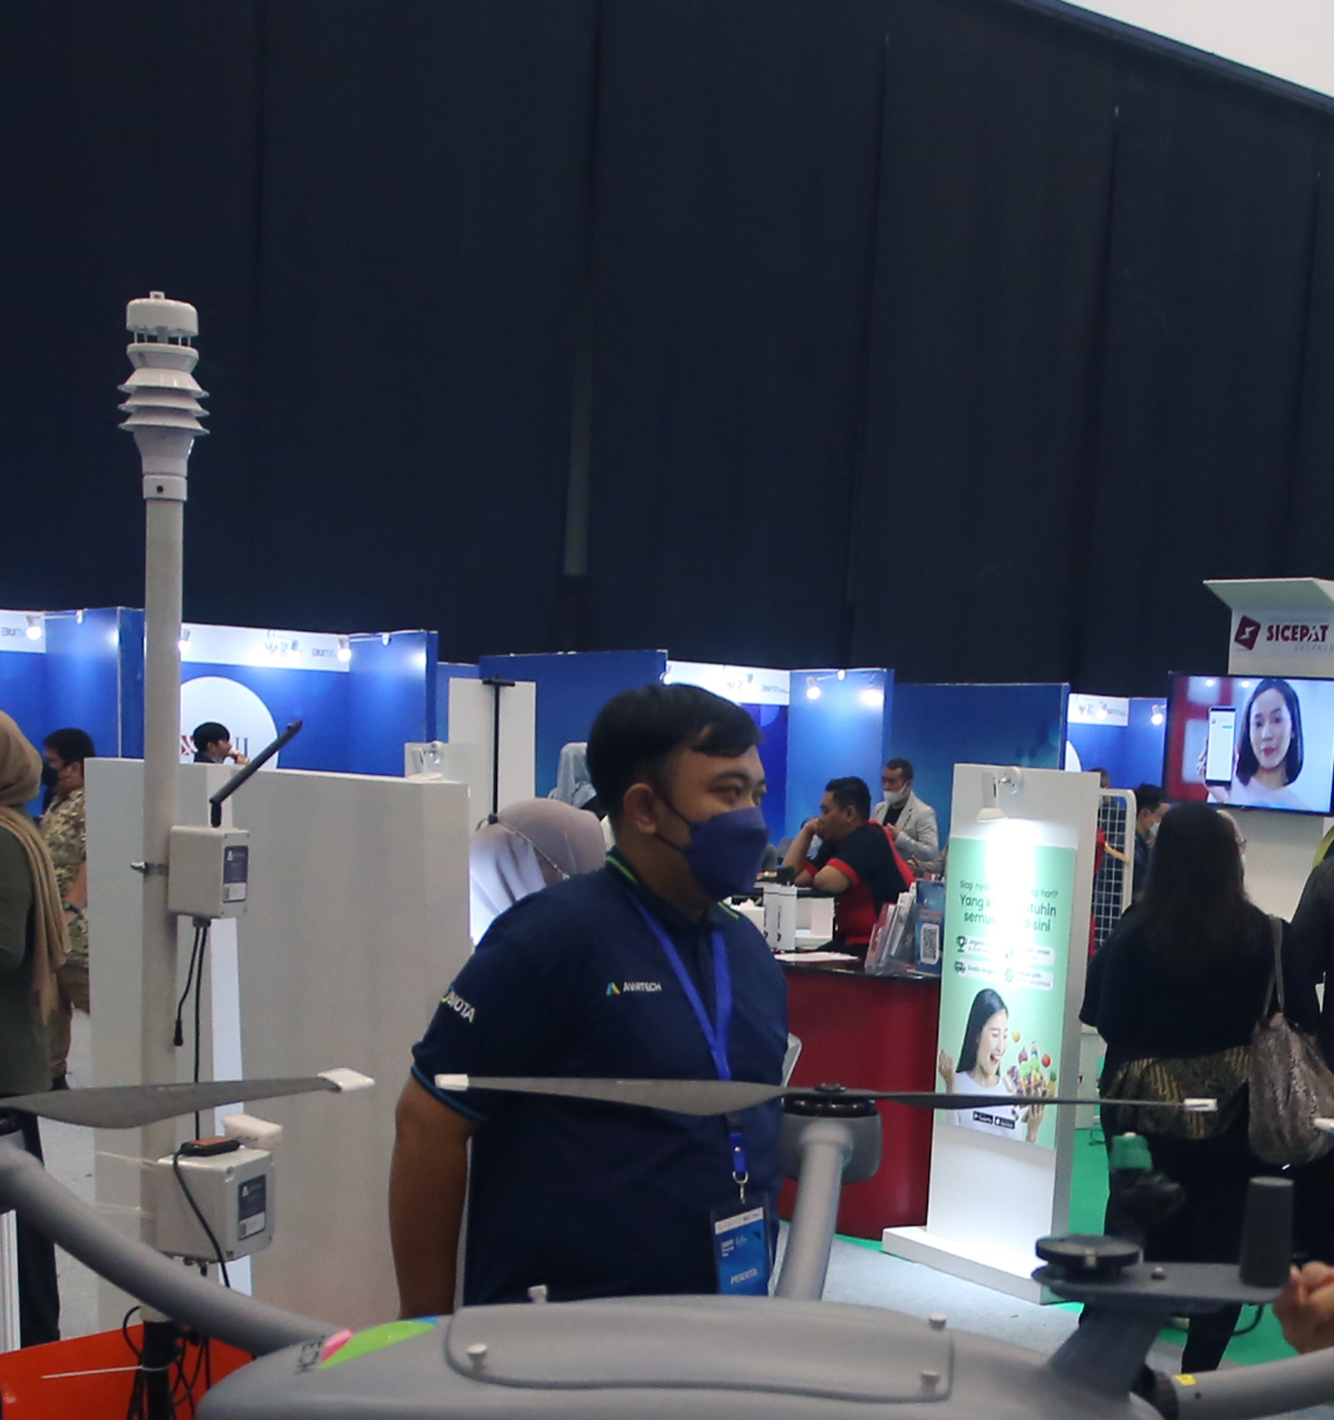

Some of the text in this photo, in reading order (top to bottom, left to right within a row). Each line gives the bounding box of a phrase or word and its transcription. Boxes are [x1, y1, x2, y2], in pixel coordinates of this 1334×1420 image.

[1266, 624, 1330, 642] SICEPAT
[960, 894, 984, 911] Yang
[1033, 919, 1051, 932] sini
